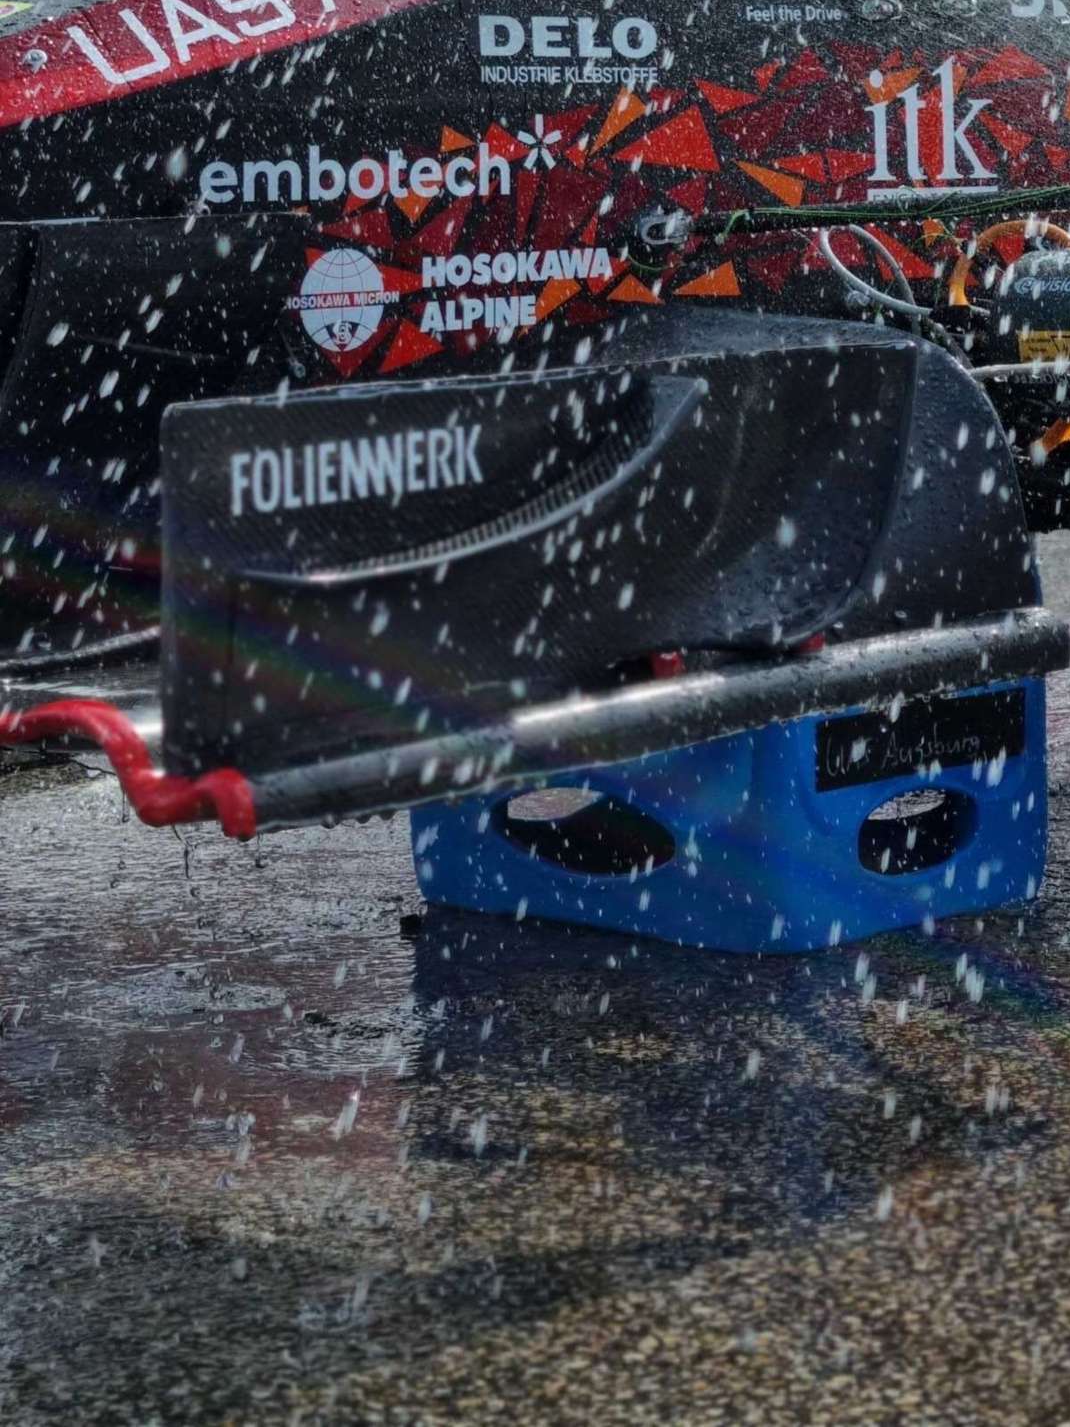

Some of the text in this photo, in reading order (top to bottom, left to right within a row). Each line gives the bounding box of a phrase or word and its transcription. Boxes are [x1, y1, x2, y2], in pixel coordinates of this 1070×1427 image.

[746, 4, 842, 21] Feel the Drive
[479, 15, 658, 58] DELO
[480, 66, 658, 84] INDUSTRIE KLEBSTOFFE
[864, 55, 999, 181] itk
[199, 144, 511, 204] embotech
[421, 248, 612, 288] HOSOKAWA
[420, 294, 537, 334] ALPINE
[230, 424, 483, 516] FOLIENWERK
